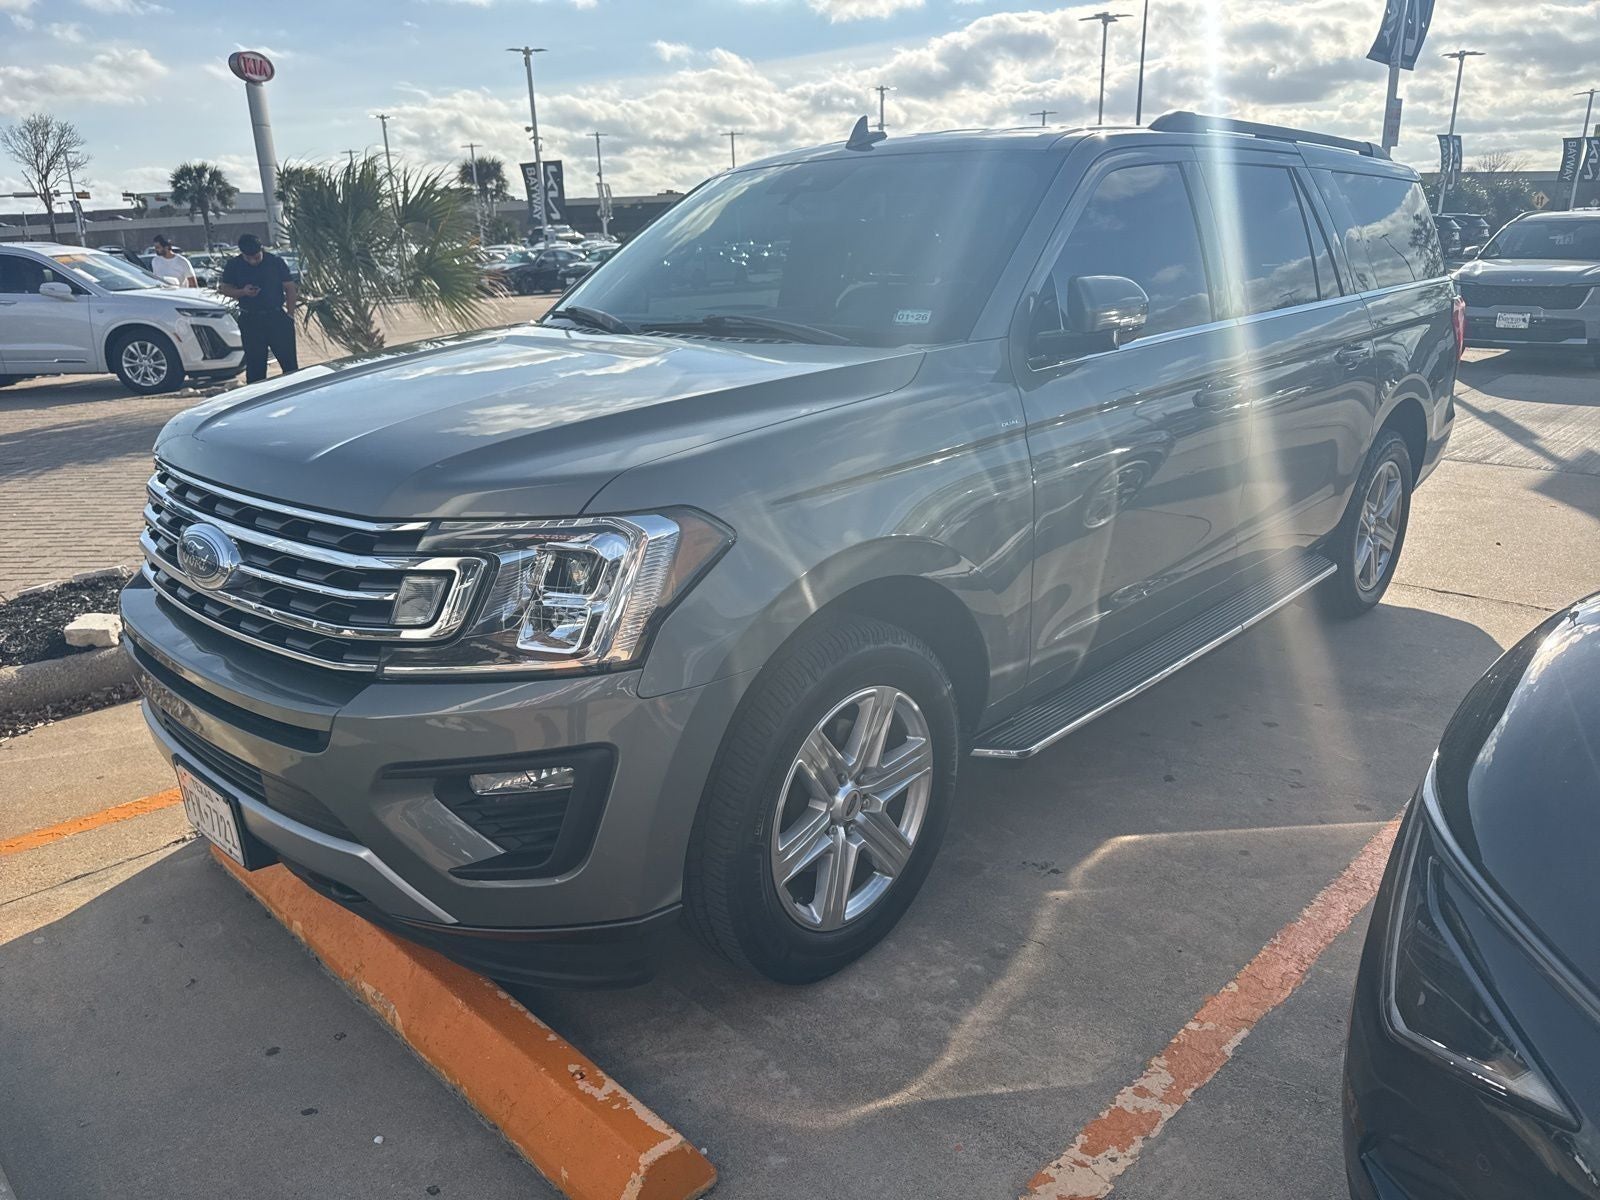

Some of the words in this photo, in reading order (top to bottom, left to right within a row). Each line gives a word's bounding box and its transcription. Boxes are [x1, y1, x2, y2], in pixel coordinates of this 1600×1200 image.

[242, 56, 268, 77] KIA
[1562, 141, 1577, 181] BAYWAY
[525, 167, 543, 220] BAYWAY
[193, 780, 215, 802] TEXAS
